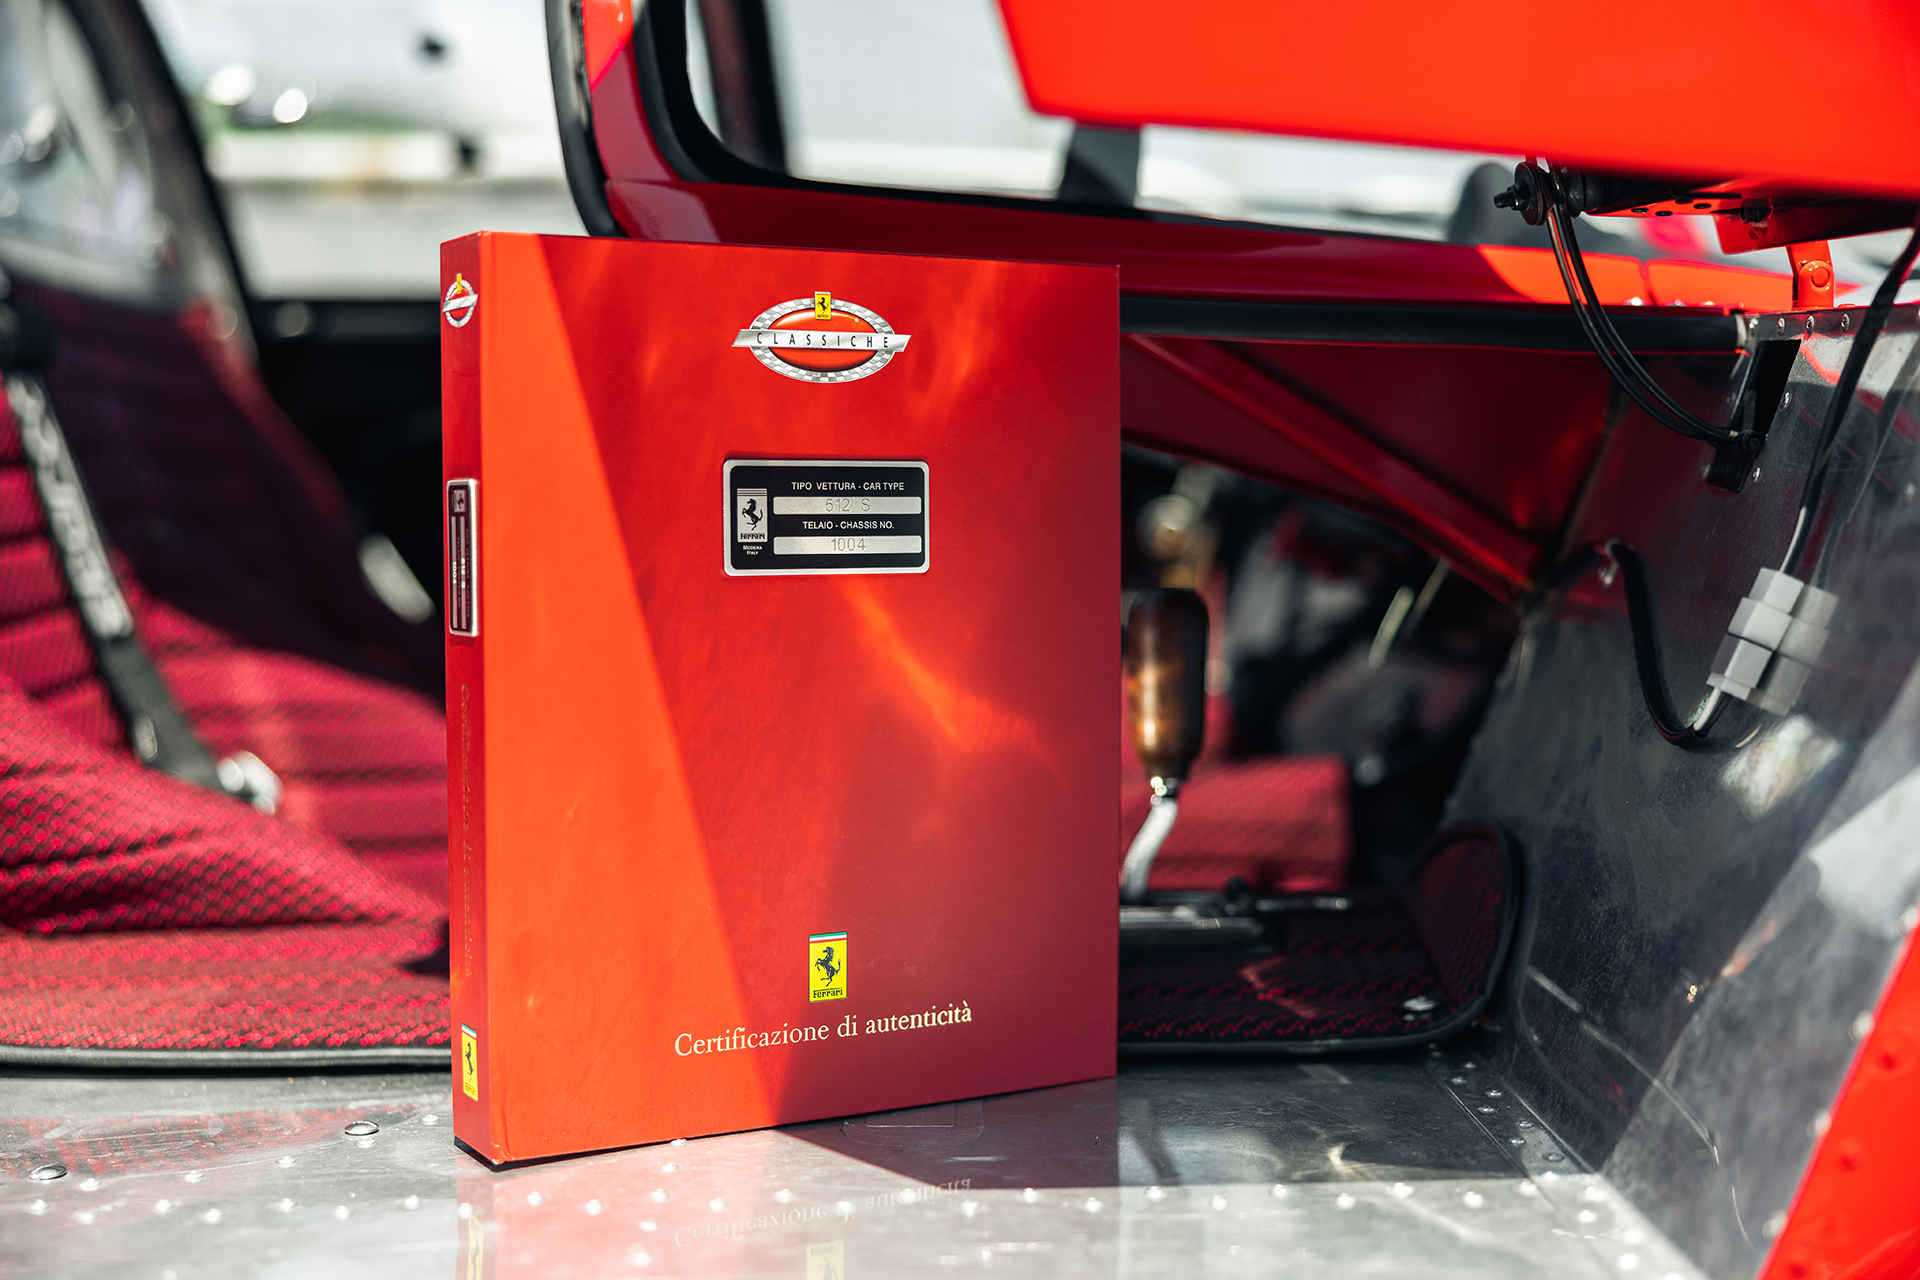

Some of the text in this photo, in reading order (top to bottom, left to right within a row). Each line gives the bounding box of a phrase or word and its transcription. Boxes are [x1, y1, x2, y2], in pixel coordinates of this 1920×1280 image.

[756, 332, 889, 348] CLASSICHE
[791, 481, 813, 491] TIPO
[816, 481, 856, 491] VETTURA
[863, 482, 882, 491] CAR
[882, 482, 905, 491] TYPE
[825, 498, 871, 512] 512 S
[802, 520, 833, 530] TELAIO
[840, 520, 878, 530] CHASSIS
[879, 520, 895, 530] NO.
[830, 537, 866, 551] 1004
[812, 987, 844, 999] Ferrari
[674, 1000, 973, 1056] Certificazione di autenticità
